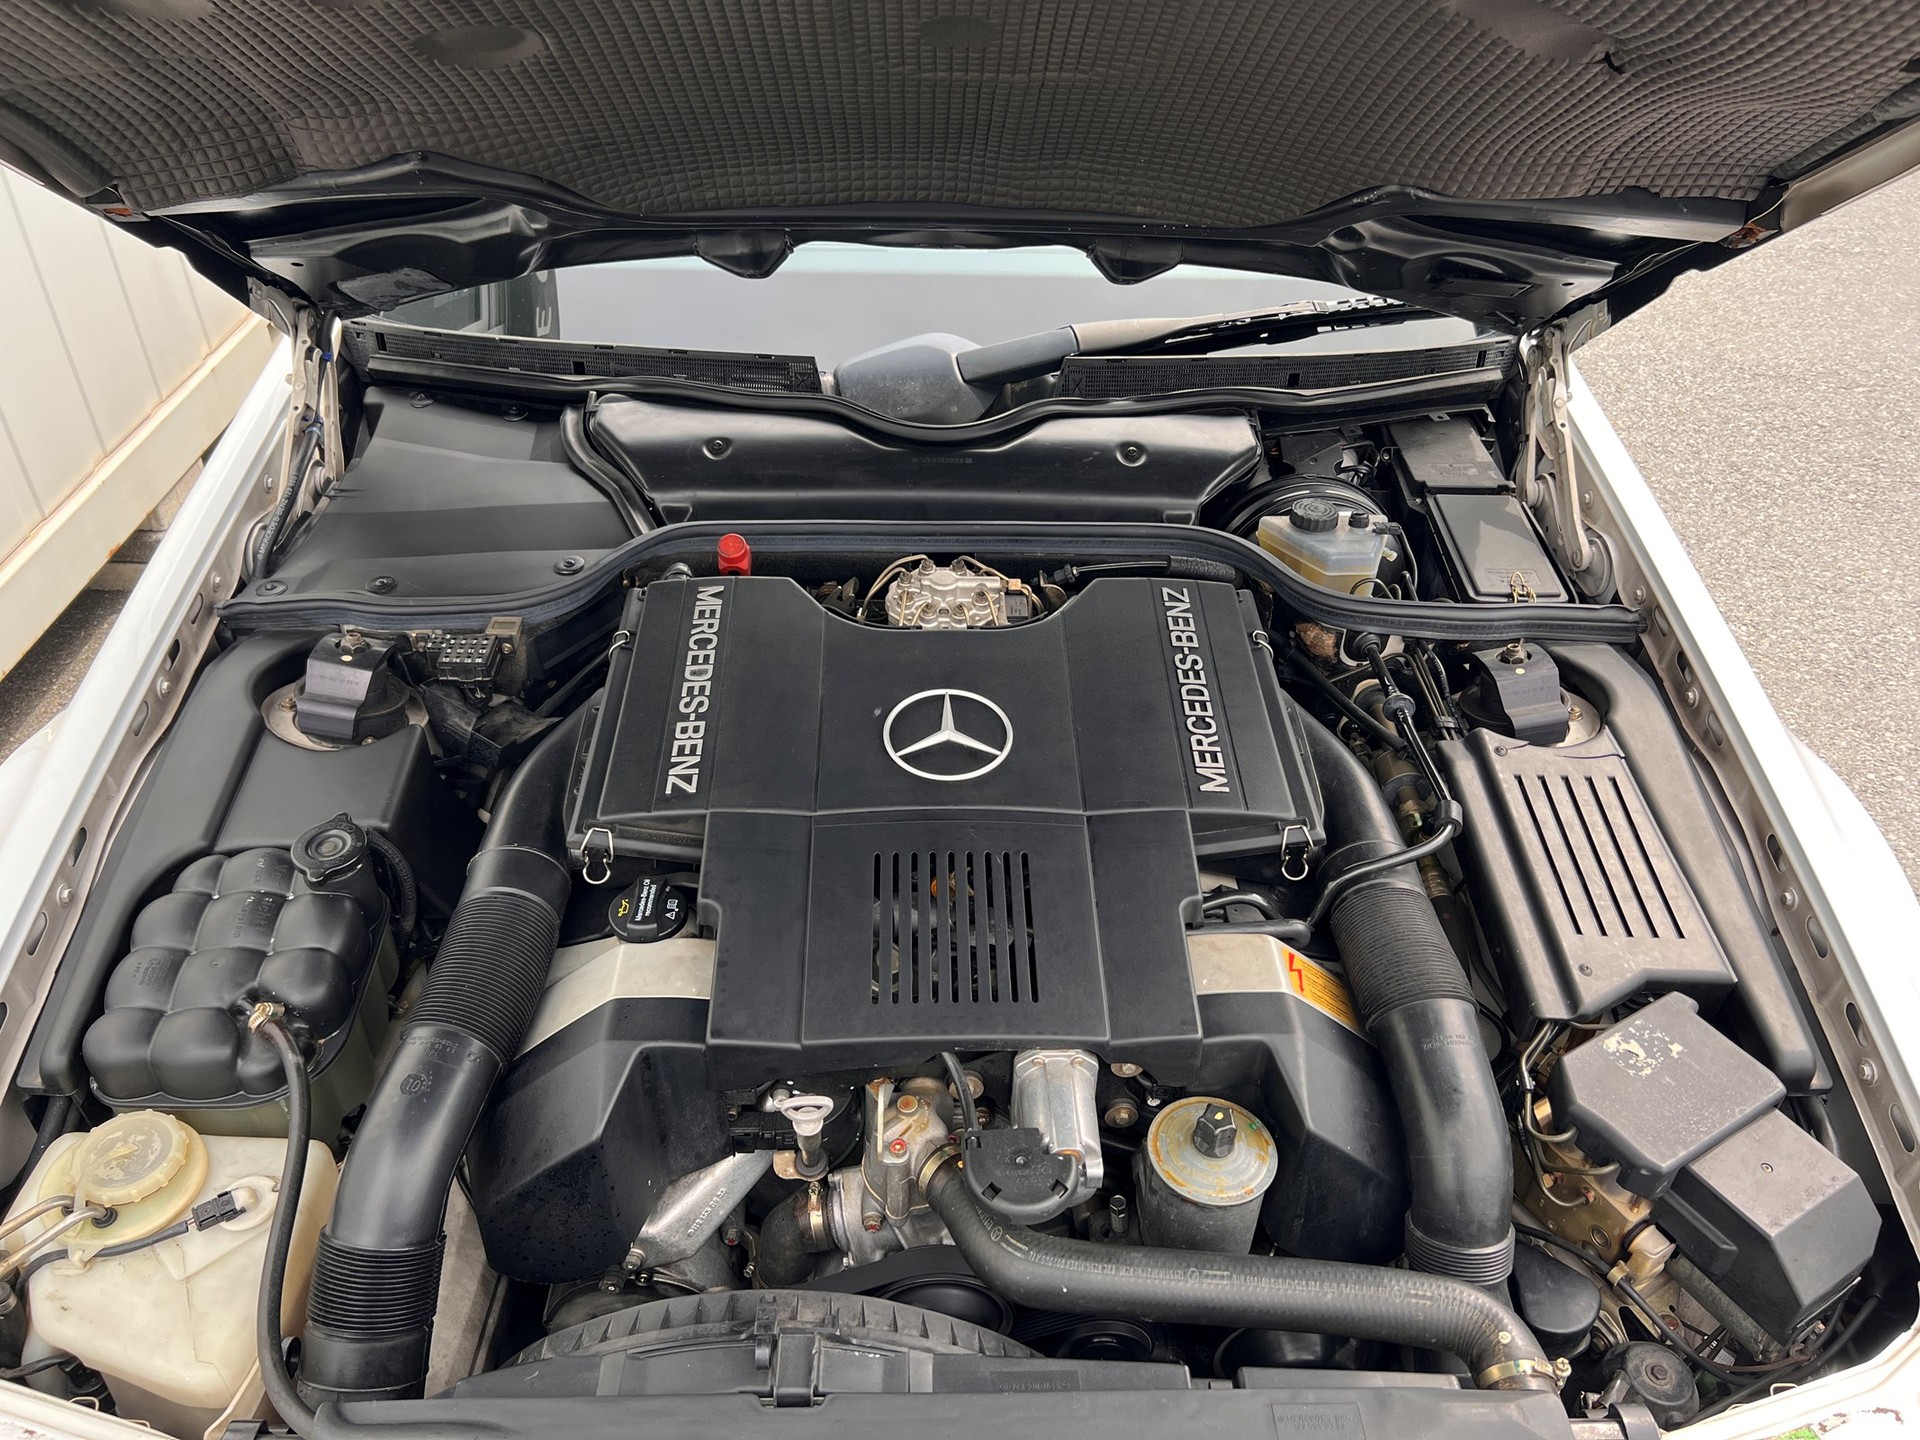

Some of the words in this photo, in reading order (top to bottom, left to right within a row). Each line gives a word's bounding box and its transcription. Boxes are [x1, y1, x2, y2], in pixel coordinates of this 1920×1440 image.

[665, 585, 725, 795] MERCEDES-BENZ
[1161, 586, 1230, 793] MERCEDES-BENZ
[634, 885, 650, 921] Mercedes-Benz
